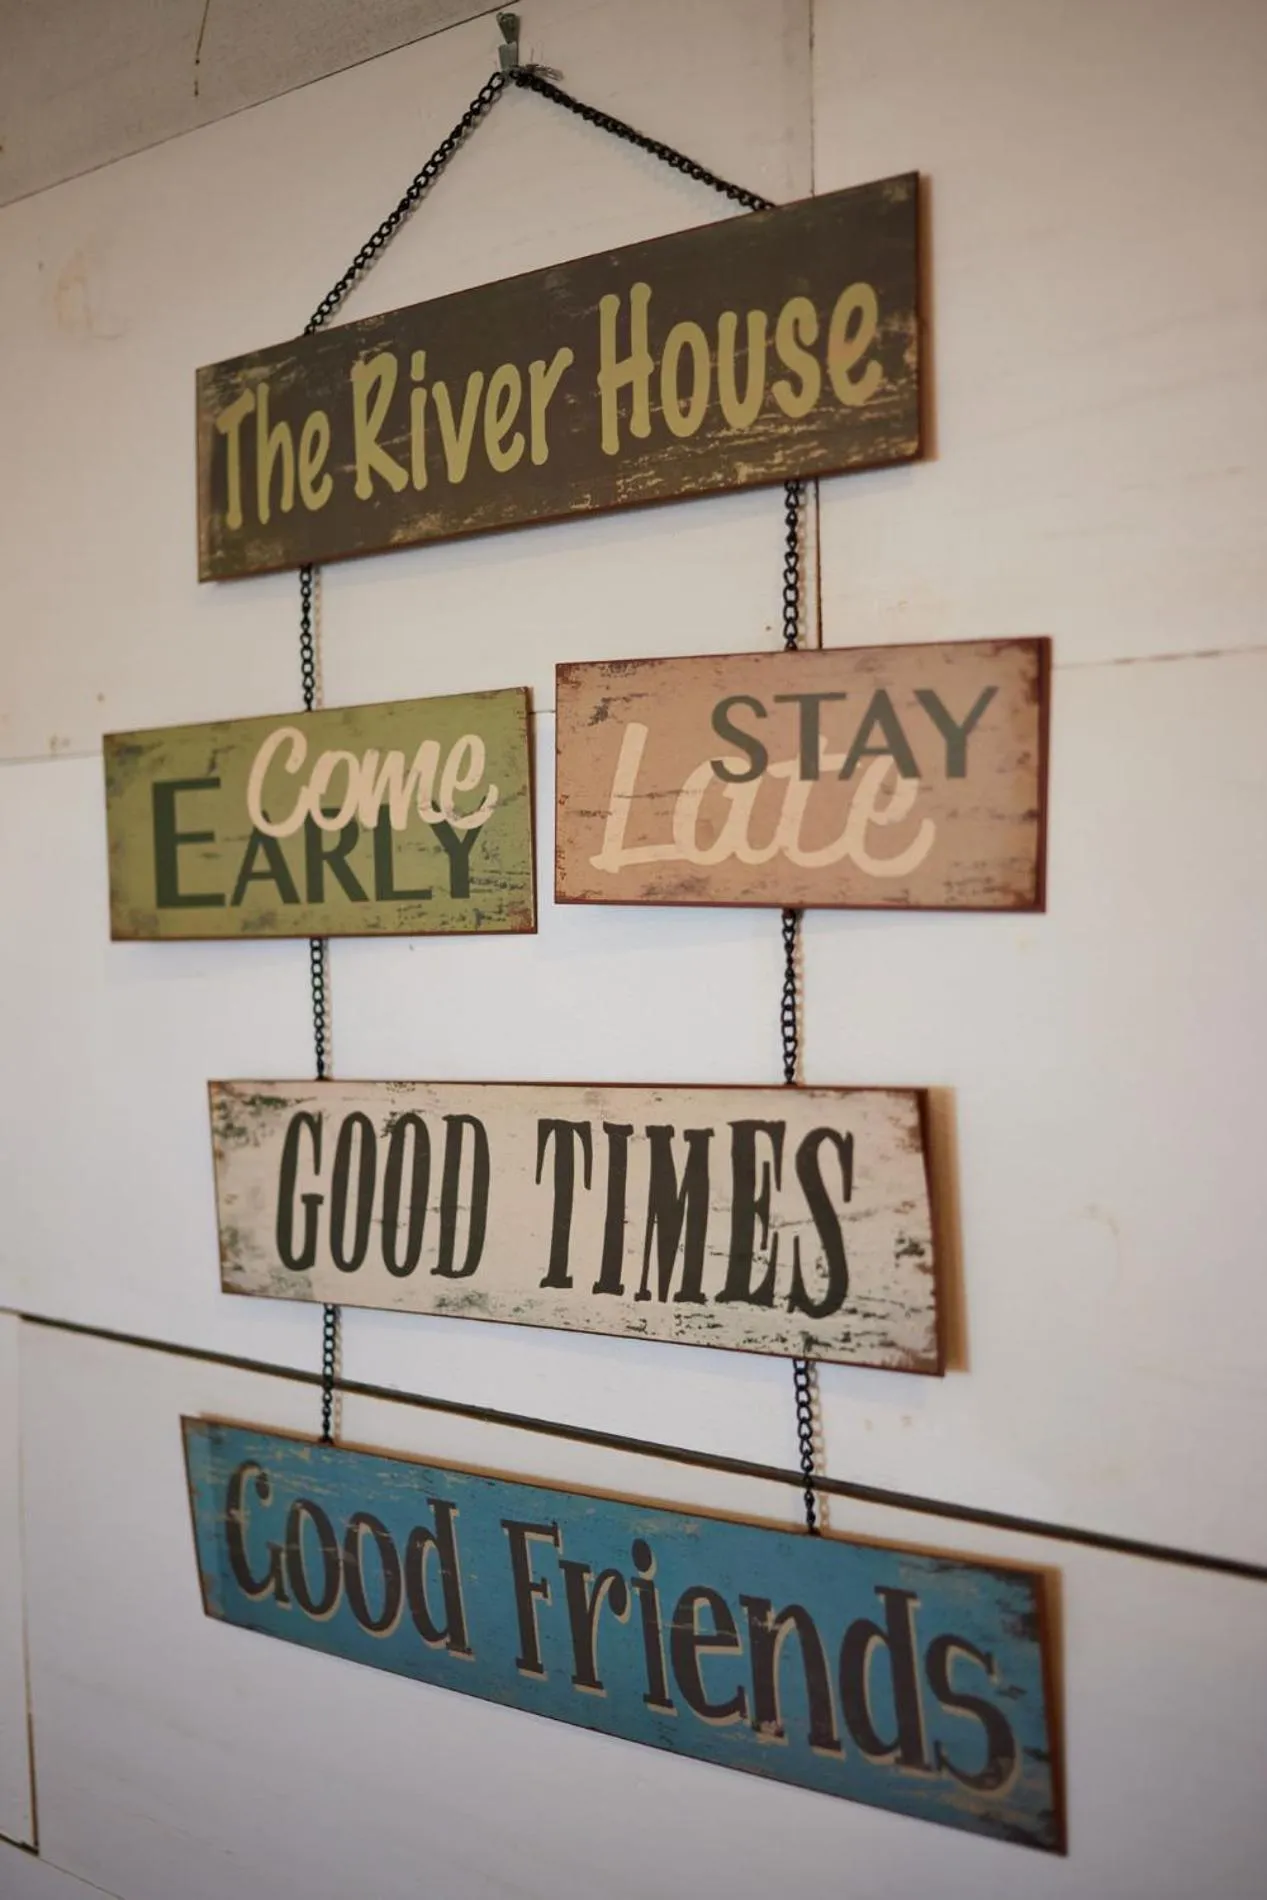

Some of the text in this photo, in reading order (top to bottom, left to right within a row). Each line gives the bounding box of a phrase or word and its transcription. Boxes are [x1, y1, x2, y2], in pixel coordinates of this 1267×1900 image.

[216, 281, 887, 531] The River House
[247, 726, 498, 838] Come
[589, 722, 936, 878] Late
[710, 686, 998, 783] STAY
[151, 777, 484, 909] EARLY
[275, 1110, 854, 1319] GOOD TIMES
[226, 1460, 1018, 1793] Good Friends
